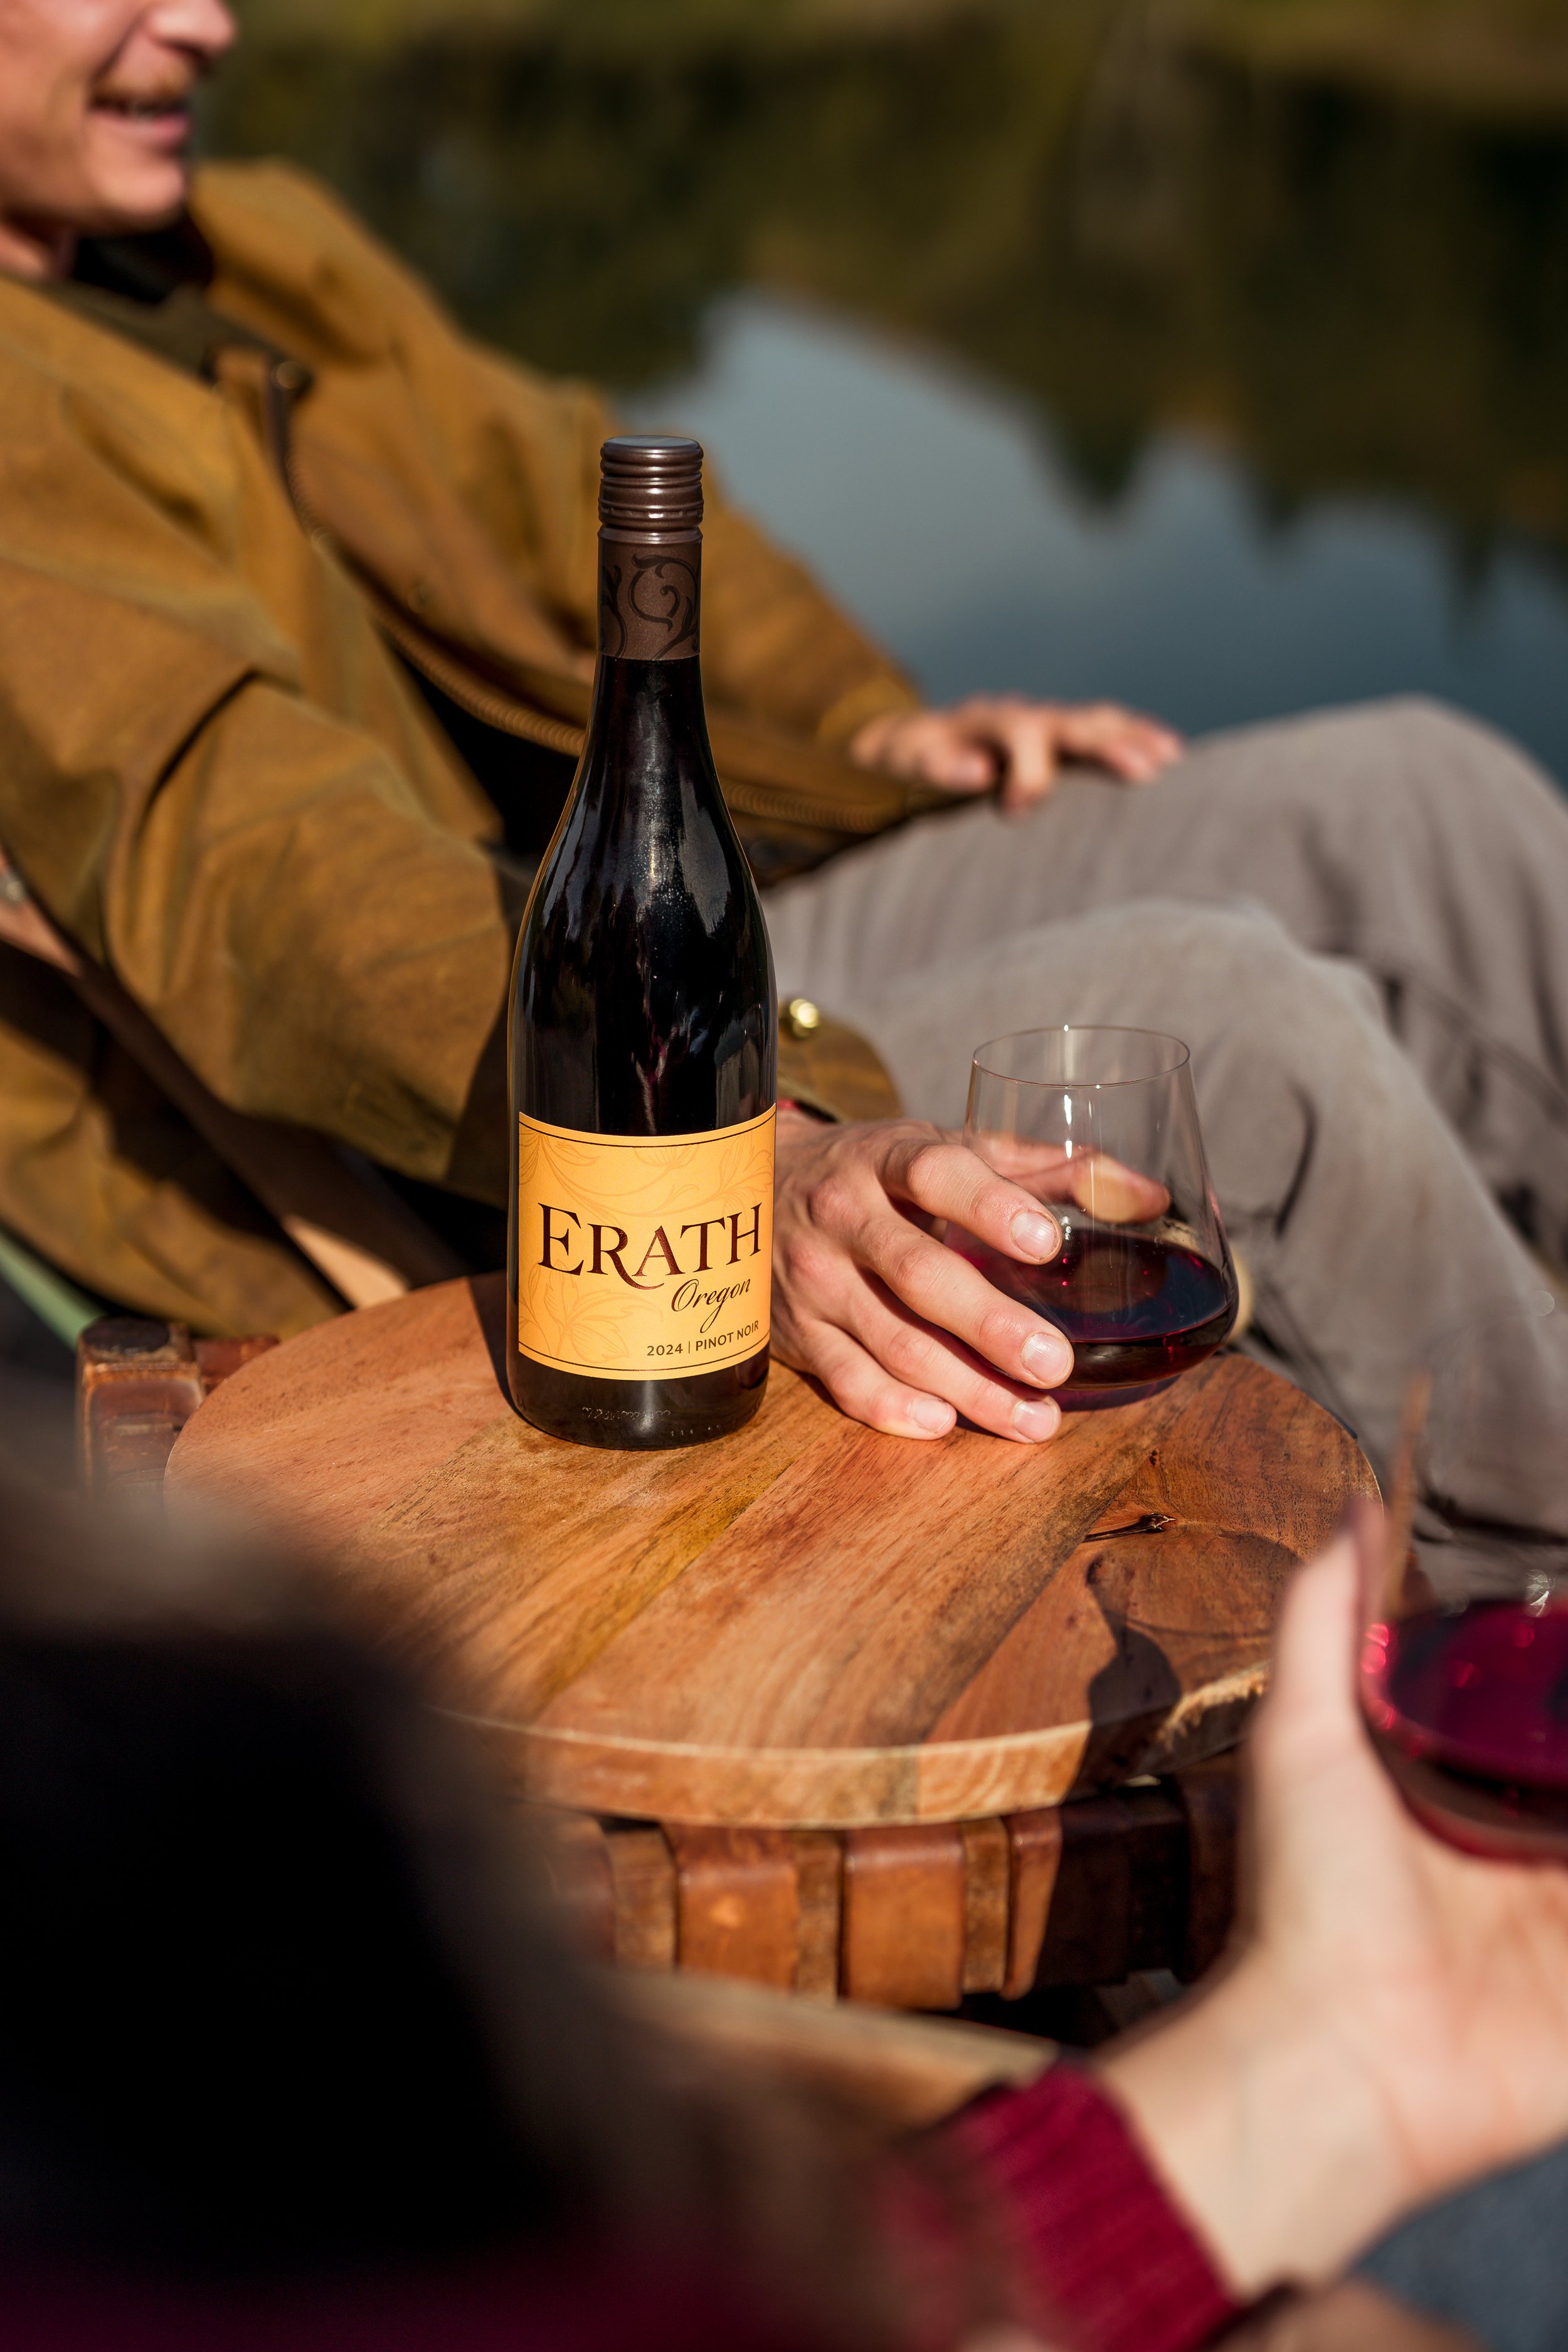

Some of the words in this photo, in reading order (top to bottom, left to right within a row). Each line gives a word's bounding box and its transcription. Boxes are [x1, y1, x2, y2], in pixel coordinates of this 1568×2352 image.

[537, 1202, 763, 1290] ERATH
[671, 1278, 751, 1333] Oregon
[647, 1343, 684, 1357] 2024
[695, 1332, 734, 1352] PINOT
[736, 1320, 760, 1341] NOIR
